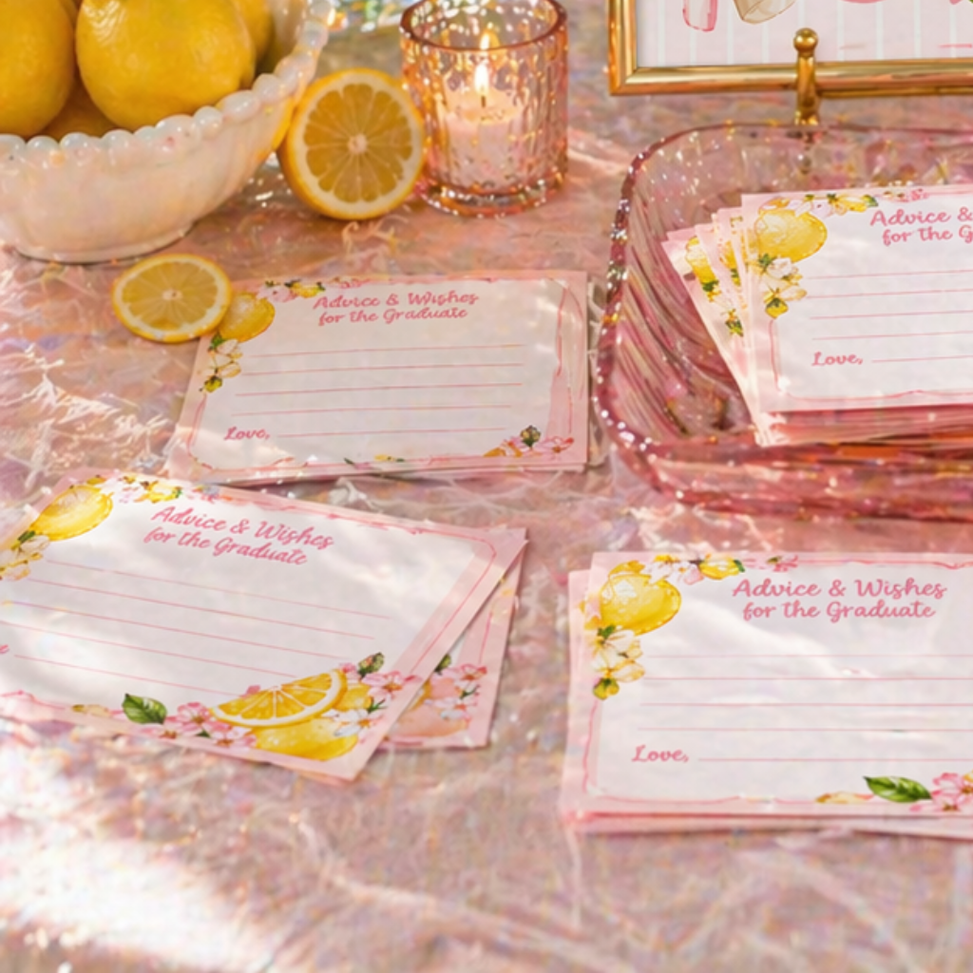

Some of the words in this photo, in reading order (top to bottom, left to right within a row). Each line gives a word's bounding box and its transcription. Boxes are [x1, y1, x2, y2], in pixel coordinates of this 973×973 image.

[869, 208, 952, 227] Advice
[956, 207, 973, 222] &
[881, 228, 913, 247] for
[917, 225, 954, 242] the
[812, 351, 864, 366] Love,
[150, 507, 227, 531] Advice
[230, 518, 250, 534] &
[254, 521, 334, 550] Wishes
[142, 527, 176, 544] for
[177, 531, 211, 549] the
[212, 536, 308, 565] Graduate
[732, 578, 822, 598] Advice
[827, 579, 847, 598] &
[855, 577, 948, 600] Wishes
[742, 601, 777, 622] for
[782, 599, 821, 619] the
[826, 599, 936, 624] Graduate
[631, 744, 689, 763] Love,
